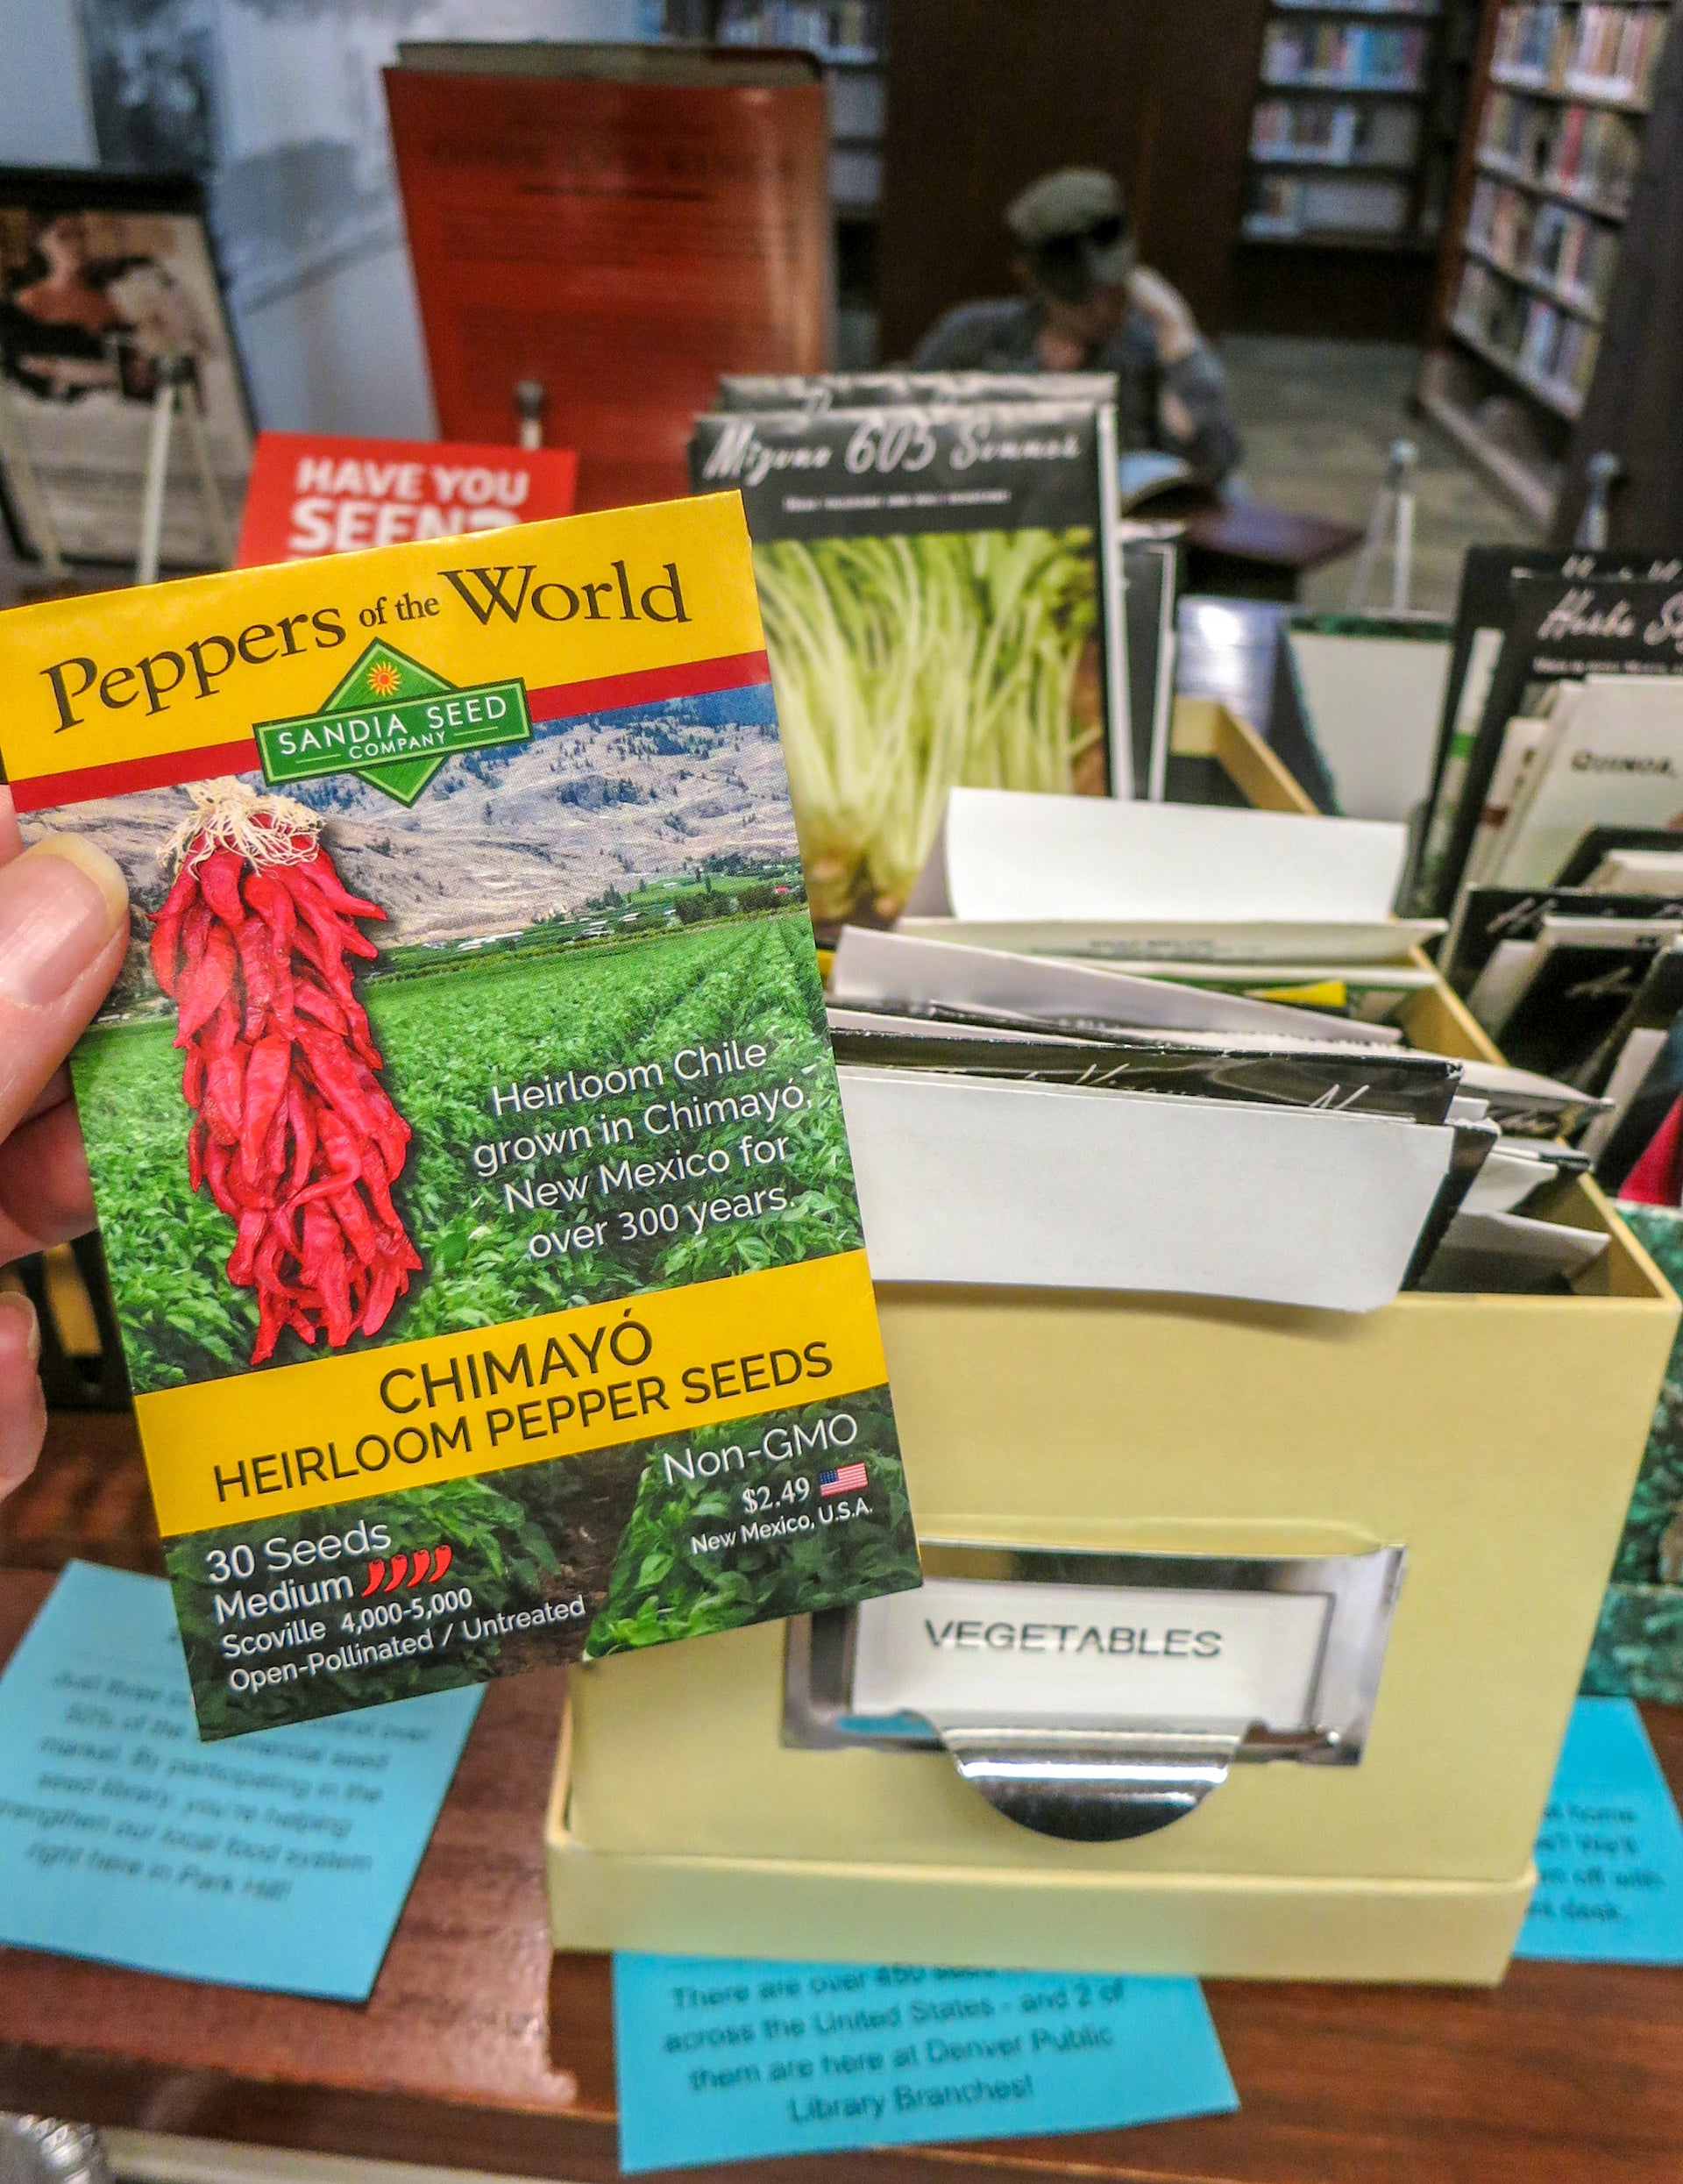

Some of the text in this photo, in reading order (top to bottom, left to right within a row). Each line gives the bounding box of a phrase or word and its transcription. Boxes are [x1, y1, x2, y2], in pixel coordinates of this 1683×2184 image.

[295, 457, 529, 506] HAVE YOU
[40, 559, 692, 734] Peppers of the World
[279, 695, 507, 756] SANDIA SEED
[349, 731, 447, 760] COMPANY
[493, 1040, 767, 1116] Heirloom Chile
[473, 1078, 812, 1177] grown in Chimayó,
[504, 1135, 789, 1213] New Mexico for
[529, 1186, 795, 1259] over 300 years.
[380, 1308, 652, 1413] CHIMAYÓ
[214, 1341, 833, 1503] HEIRLOOM PEPPER SEEDS
[663, 1413, 857, 1484] Non-GMO
[691, 1497, 873, 1554] New Mexico, U.S.A.
[742, 1476, 810, 1514] $2.49
[205, 1519, 392, 1583] 30 Seeds
[214, 1575, 354, 1625] Medium
[221, 1587, 472, 1660] Scoville 4,000-5,000
[229, 1595, 586, 1694] Open-Pollinated / Untreated
[925, 1618, 1224, 1657] VEGETABLES
[663, 2024, 756, 2053] across
[761, 2018, 806, 2041] the
[811, 2003, 901, 2036] United
[909, 1995, 995, 2024] States
[1019, 1985, 1069, 2014] and
[1073, 1980, 1092, 2008] 2
[1098, 1976, 1124, 2006] of
[671, 1986, 749, 2010] There
[758, 1979, 801, 2001] are
[808, 1973, 865, 1995] over
[688, 2024, 1113, 2094] them are here at Denver Public
[787, 2094, 886, 2126] Library
